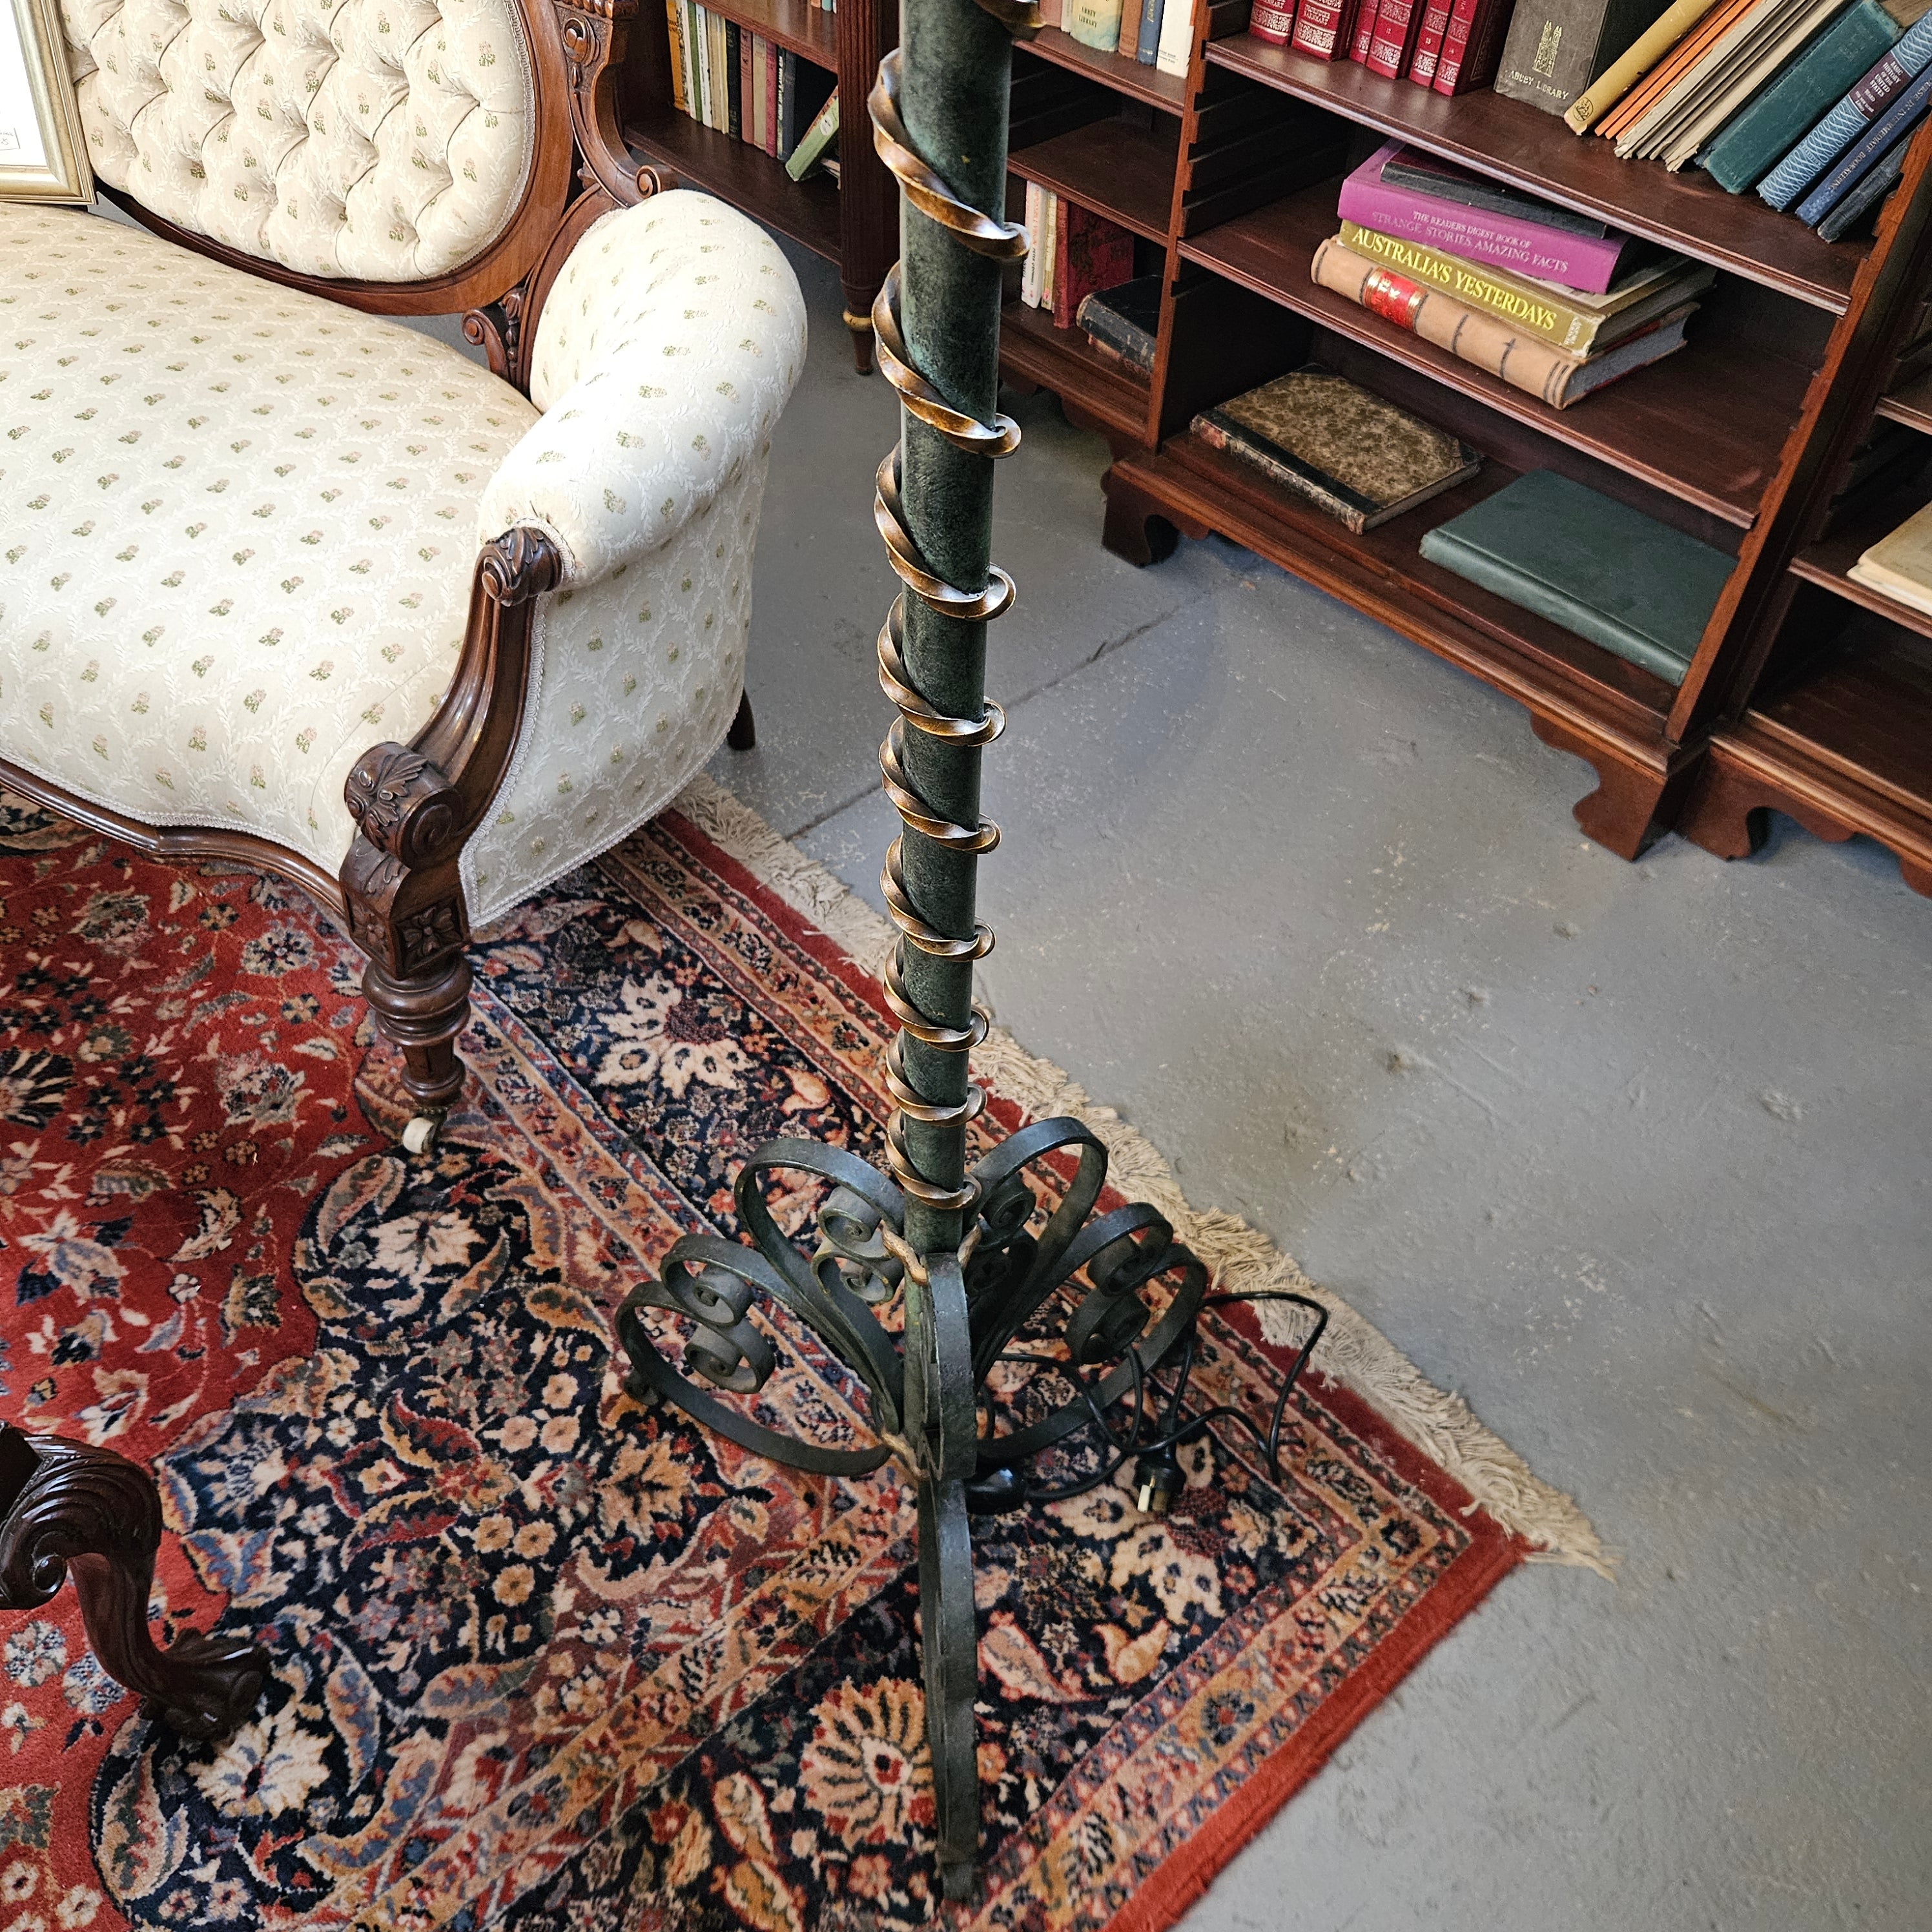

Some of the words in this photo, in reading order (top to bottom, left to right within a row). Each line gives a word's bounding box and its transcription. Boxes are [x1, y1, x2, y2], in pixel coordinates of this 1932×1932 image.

[1079, 15, 1097, 28] LIBRARY
[1883, 62, 1901, 83] HISTORY
[1890, 61, 1904, 76] BASIC
[1508, 70, 1534, 85] ABBEY
[1536, 81, 1569, 100] LIBRARY
[1870, 79, 1885, 97] STATES
[1875, 74, 1891, 93] UNITED
[1866, 108, 1907, 152] INTERMEDIATE
[1372, 211, 1421, 232] STRANGE
[1474, 240, 1531, 263] AMAZING
[1532, 253, 1569, 273] FACTS
[1413, 211, 1430, 223] THE
[1466, 225, 1495, 240] DIGEST
[1495, 233, 1519, 247] BOOK
[1519, 240, 1532, 250] OF
[1352, 227, 1453, 284] AUSTRALIA'S
[1455, 269, 1557, 331] YESTERDAYS
